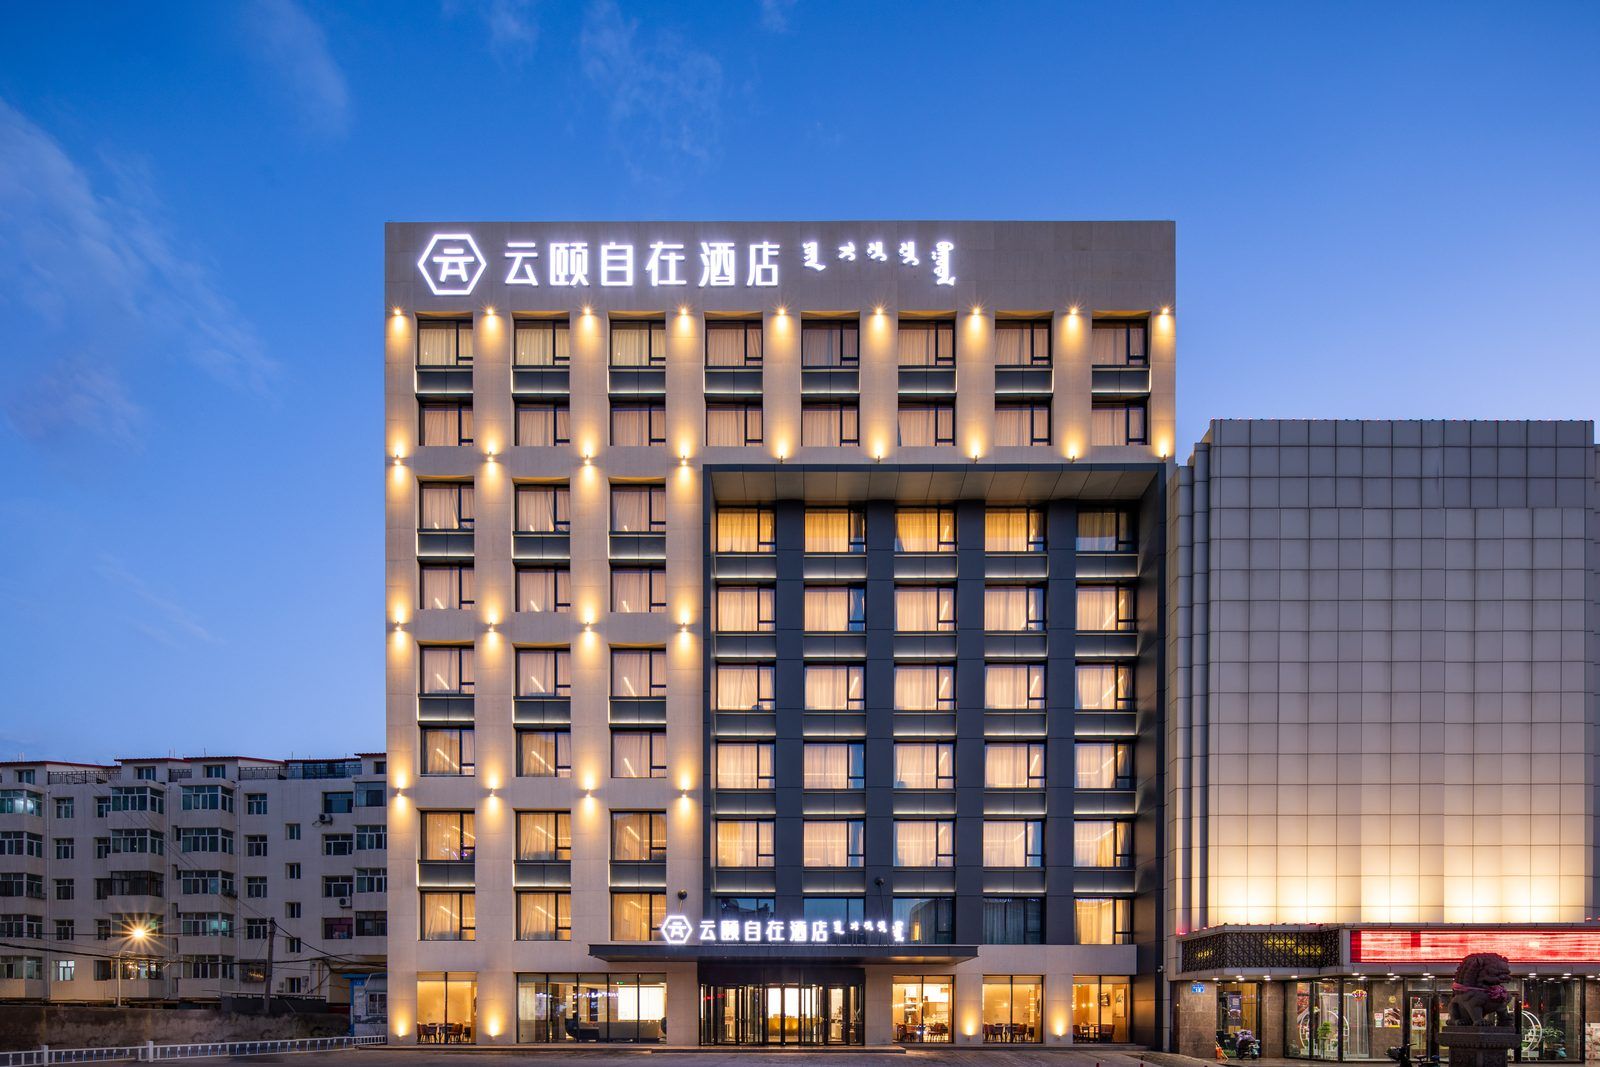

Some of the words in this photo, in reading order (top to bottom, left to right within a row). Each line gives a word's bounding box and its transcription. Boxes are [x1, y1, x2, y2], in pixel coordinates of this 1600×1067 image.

[504, 240, 781, 288] 云颐自在酒店
[699, 919, 828, 942] 云颐自在酒店
